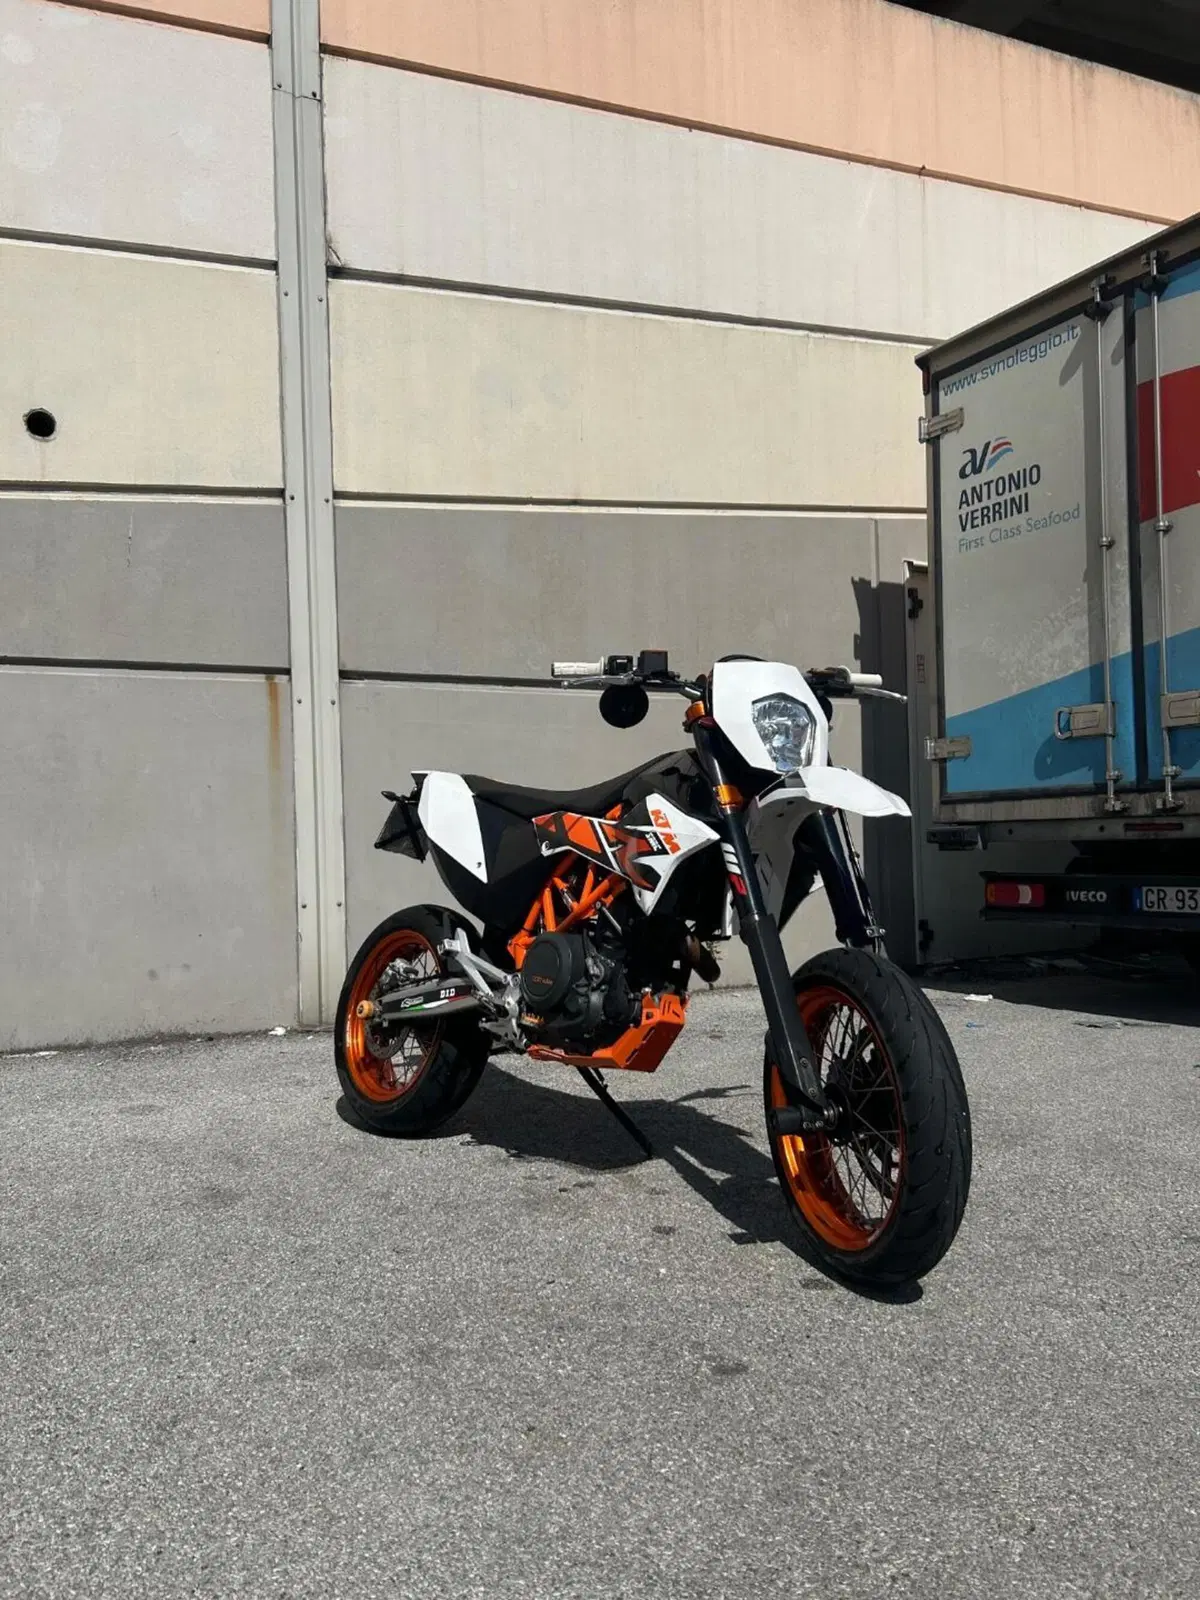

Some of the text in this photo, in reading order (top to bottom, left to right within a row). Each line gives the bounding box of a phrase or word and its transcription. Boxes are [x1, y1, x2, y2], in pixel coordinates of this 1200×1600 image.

[943, 325, 1079, 396] www.svnoleggio.it
[959, 464, 1041, 510] ANTONIO
[959, 492, 1029, 532] VERRINI
[959, 502, 1080, 553] First Class Seafood
[1066, 890, 1107, 902] IVECO
